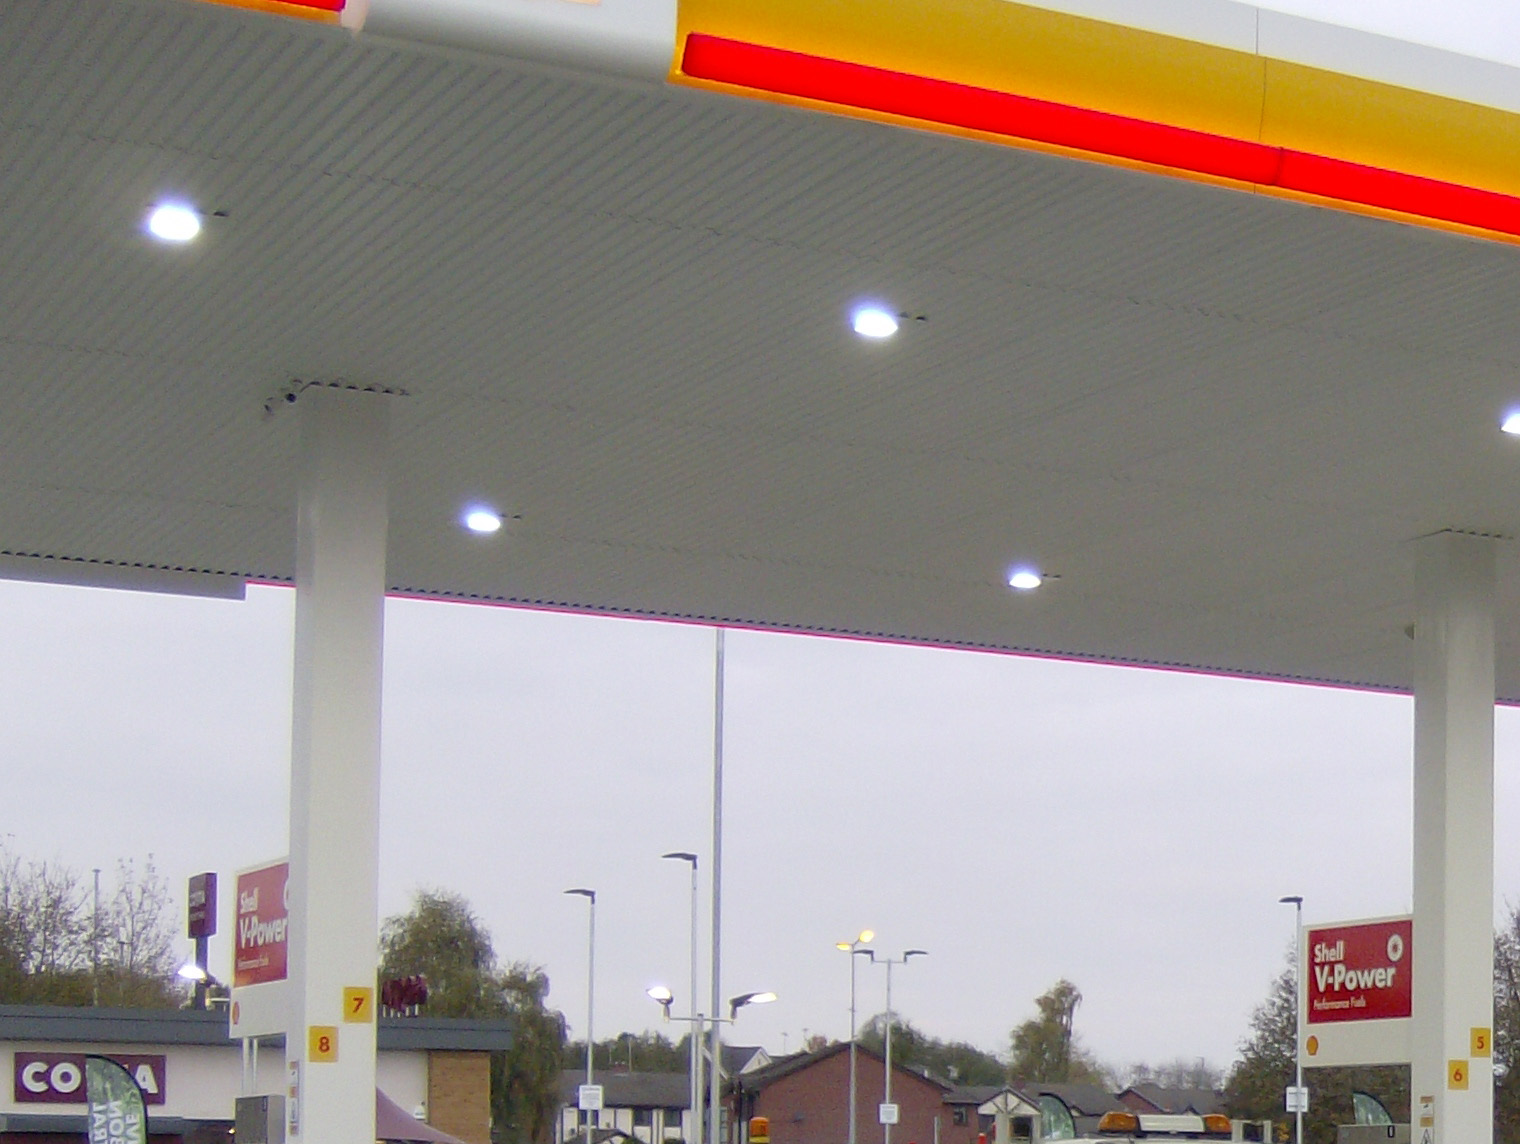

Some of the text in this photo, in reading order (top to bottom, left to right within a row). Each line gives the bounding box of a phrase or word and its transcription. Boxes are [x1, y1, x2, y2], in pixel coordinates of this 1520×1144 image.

[239, 886, 260, 914] Shell
[239, 916, 289, 949] V-Power
[1313, 940, 1344, 963] Shell
[1314, 963, 1396, 993] V-Power
[352, 997, 364, 1013] 7
[318, 1037, 330, 1053] 8
[1476, 1036, 1485, 1050] 5
[22, 1061, 159, 1094] COA
[1453, 1068, 1463, 1082] 6
